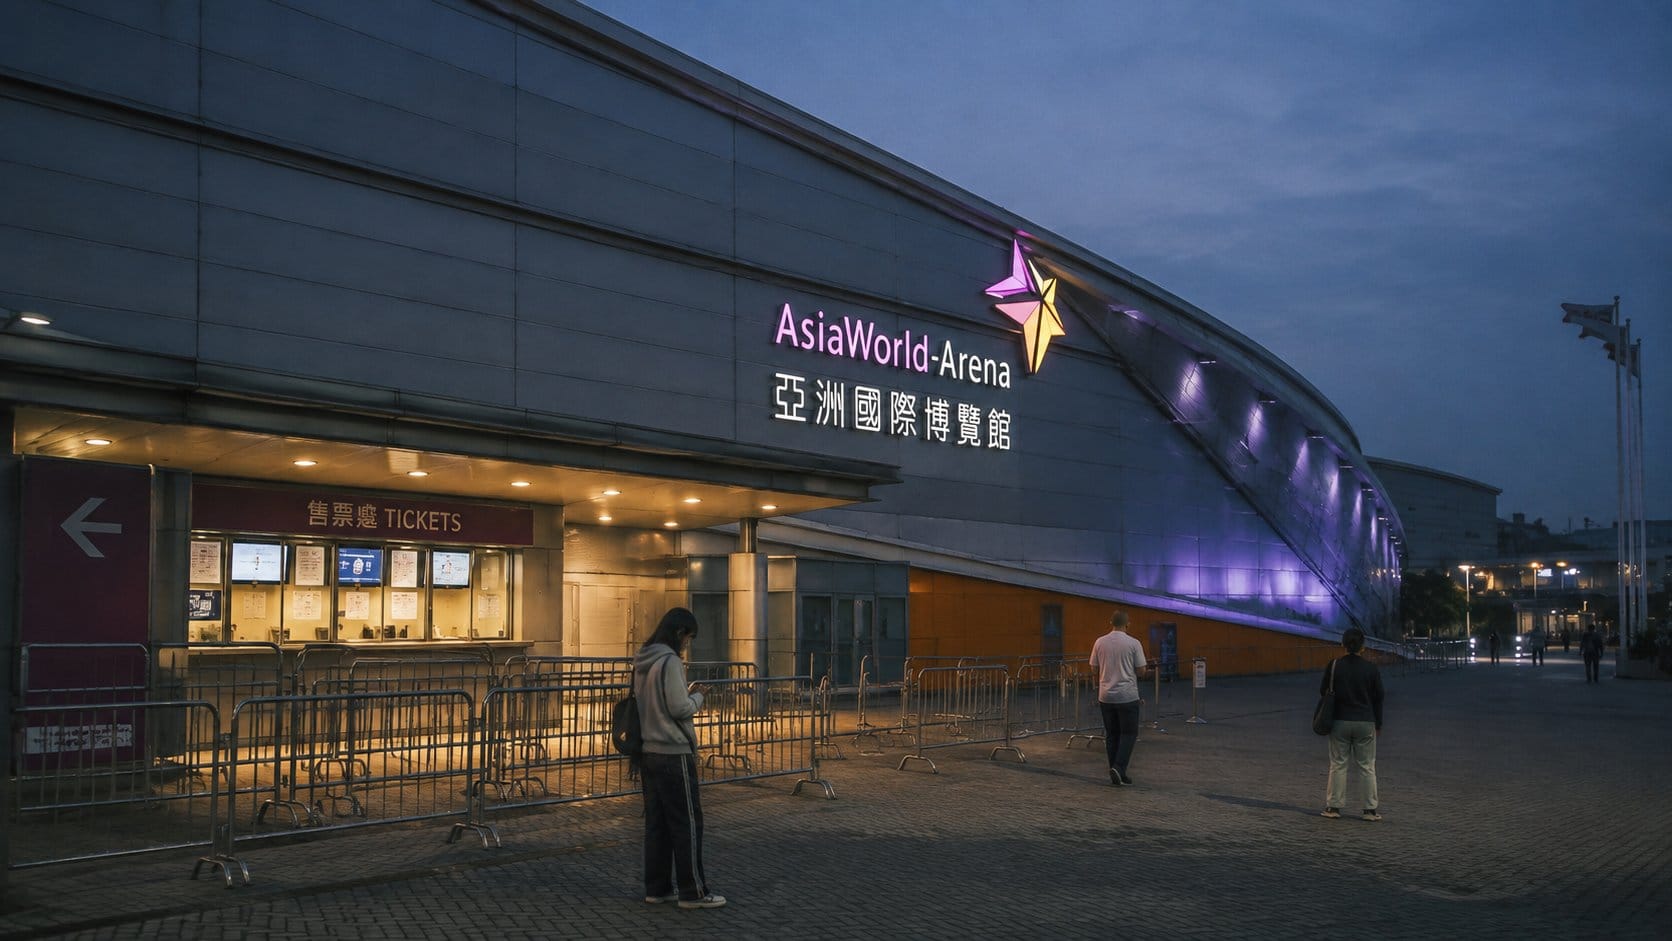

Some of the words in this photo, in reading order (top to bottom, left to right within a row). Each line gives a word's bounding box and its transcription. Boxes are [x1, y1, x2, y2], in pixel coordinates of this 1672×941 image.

[775, 302, 1011, 389] AsiaWorld-Arena
[774, 372, 1011, 450] 亞洲國際博覽館
[384, 507, 462, 532] TICKETS
